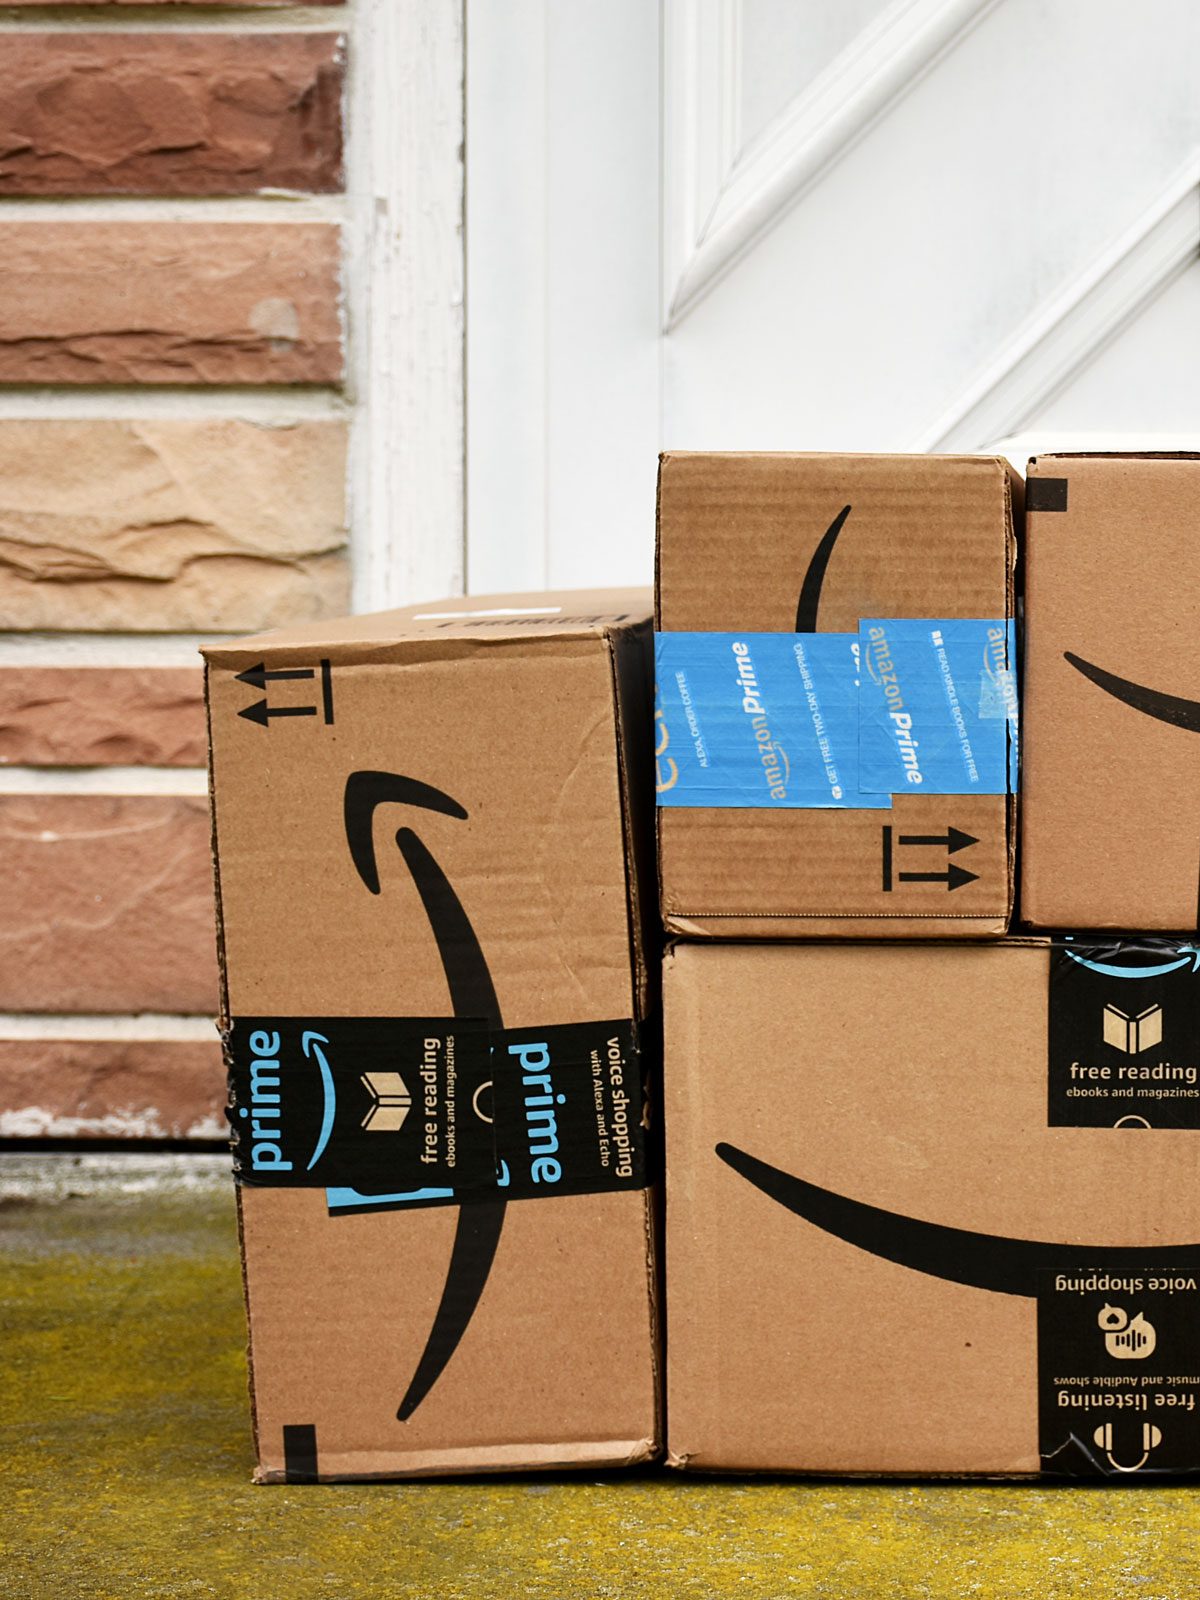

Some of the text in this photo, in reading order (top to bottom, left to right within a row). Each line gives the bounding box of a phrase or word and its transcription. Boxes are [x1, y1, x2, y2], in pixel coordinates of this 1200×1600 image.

[675, 671, 691, 705] COFFEE
[685, 706, 699, 736] ORDER
[793, 643, 838, 783] GET FREE TWO-DAY SHIPPING
[936, 647, 978, 781] READ KINDLE BOOKS FOR FREE
[239, 1030, 293, 1171] prime
[418, 1037, 441, 1163] free reading
[445, 1036, 456, 1167] ebooks and magazines
[508, 1042, 566, 1184] prime
[591, 1050, 610, 1166] with Alexa and Echo
[607, 1037, 634, 1176] voice shopping
[1067, 1087, 1199, 1099] ebooks and magazines
[1071, 1063, 1196, 1083] free reading
[1056, 1275, 1196, 1295] voice shopping
[1054, 1376, 1200, 1387] music and Audible shows
[1058, 1391, 1195, 1410] free listening
